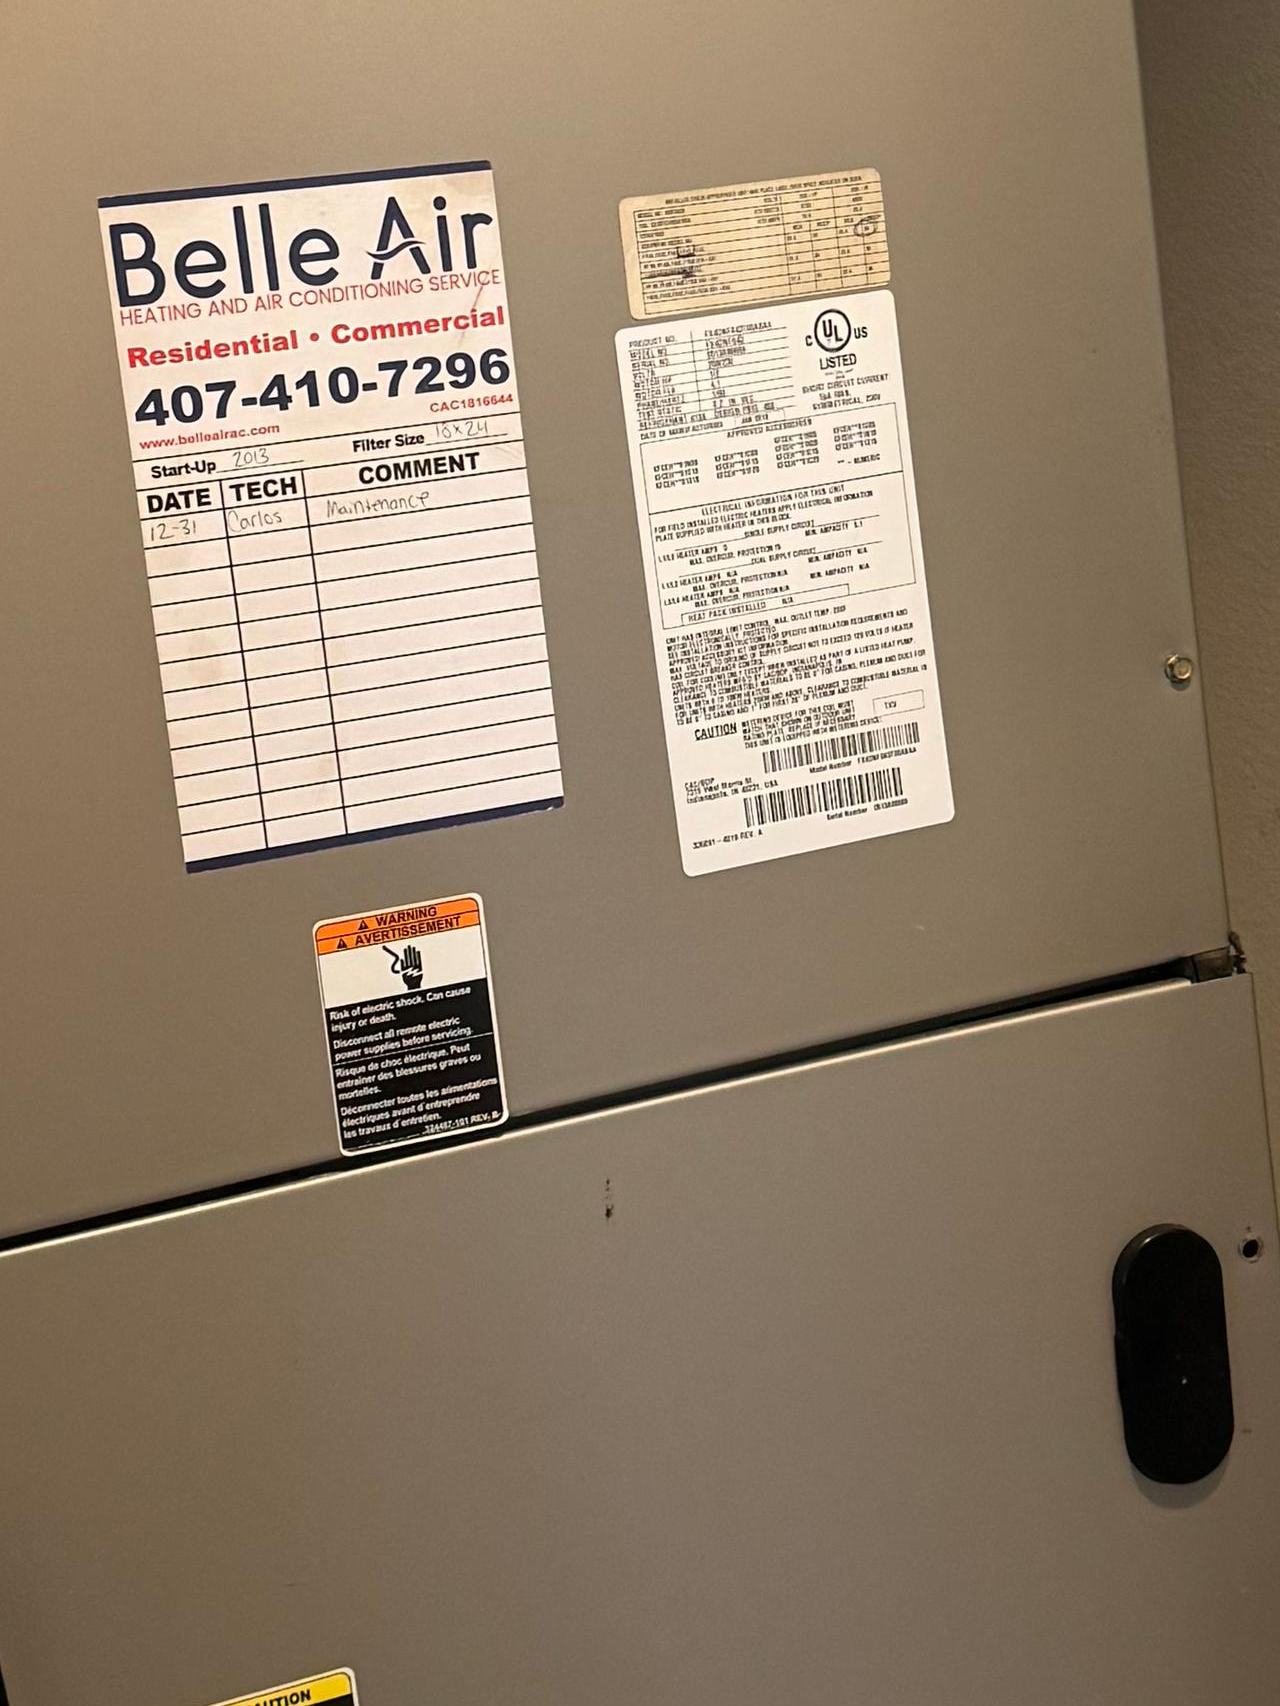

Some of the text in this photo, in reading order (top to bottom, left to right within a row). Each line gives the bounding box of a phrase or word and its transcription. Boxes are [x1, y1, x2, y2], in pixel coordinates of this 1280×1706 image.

[108, 195, 493, 308] Belle Air
[119, 268, 501, 327] HEATING AND AIR CONDITIONING SERVICE
[127, 305, 505, 369] Residential Commercial
[822, 318, 844, 343] UL
[853, 326, 868, 340] US
[819, 352, 857, 371] LISTED
[134, 347, 510, 427] 407-410-7296
[352, 433, 425, 453] Filter Size
[150, 459, 217, 479] Start-Up
[358, 451, 480, 485] COMMENT
[146, 487, 212, 514] DATE
[228, 476, 298, 502] TECH
[227, 509, 283, 533] Carlos
[694, 721, 738, 742] CAUTION
[374, 906, 437, 927] WARNING
[355, 915, 461, 946] AVERTISSEMENT
[329, 986, 471, 1021] Risk of electric shock. Can cause
[331, 1012, 397, 1033] injury or death.
[332, 1016, 461, 1050] Disconnect all remote electric
[334, 1026, 472, 1062] power supplies before servicing.
[334, 1065, 367, 1078] Risque
[367, 1061, 380, 1072] de
[380, 1057, 403, 1069] choc
[449, 1043, 471, 1055] Peut
[377, 1071, 395, 1081] des
[394, 1062, 438, 1078] blessures
[438, 1056, 469, 1071] graves
[469, 1053, 482, 1062] ou
[338, 1085, 382, 1101] mortelles.
[396, 1092, 425, 1105] toutes
[425, 1089, 440, 1099] les
[391, 1104, 417, 1118] avant
[343, 1129, 358, 1139] les
[358, 1122, 392, 1136] travaux
